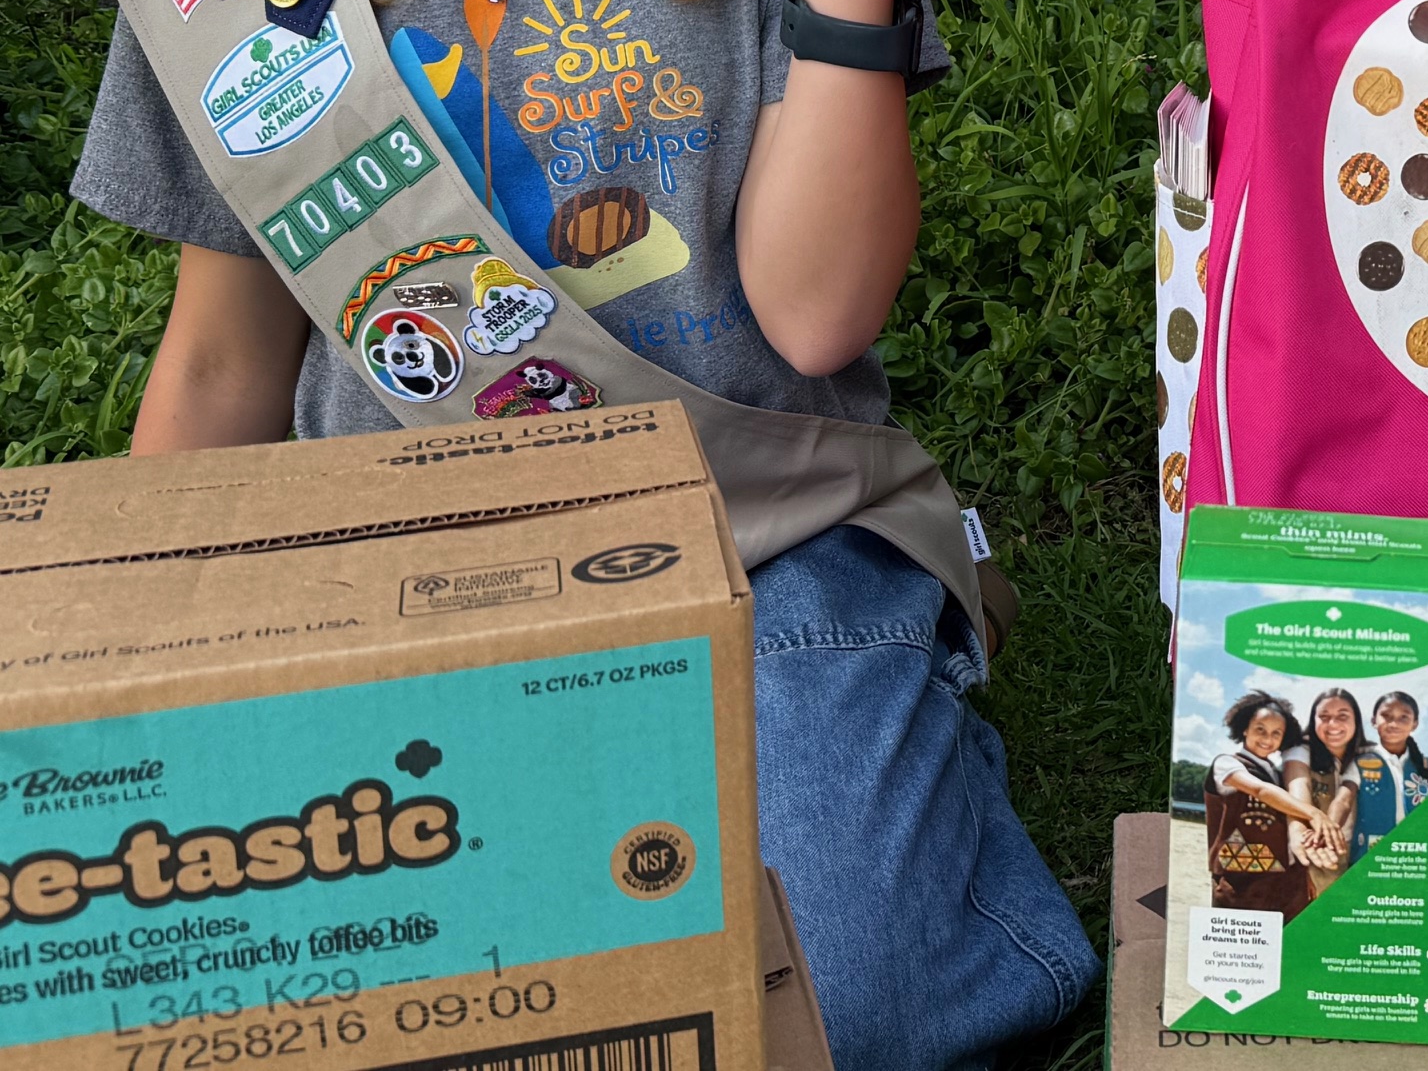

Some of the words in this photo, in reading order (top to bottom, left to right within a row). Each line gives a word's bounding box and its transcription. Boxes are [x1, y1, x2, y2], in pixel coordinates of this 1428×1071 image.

[555, 23, 661, 83] Sun
[211, 86, 243, 115] GIRL
[241, 44, 300, 93] SCOUTS
[255, 122, 278, 145] LOS
[277, 86, 325, 130] ANGELES
[258, 79, 308, 121] GREATER
[518, 71, 644, 132] Surf
[649, 68, 703, 120] &
[268, 131, 423, 257] 70403
[482, 295, 516, 322] STORM
[485, 299, 530, 333] TROOPER
[519, 305, 543, 324] 2025
[516, 420, 590, 438] NOT
[603, 410, 655, 424] DO
[402, 431, 503, 451] DROP
[1255, 623, 1282, 636] The
[1283, 624, 1311, 637] Girl
[1312, 626, 1354, 640] Scout
[1355, 628, 1410, 642] Mission
[521, 680, 542, 696] 12
[545, 671, 605, 693] CT/6.7
[608, 666, 635, 684] OZ
[639, 658, 689, 680] PKGS
[12, 759, 165, 798] Brownie
[623, 830, 681, 854] CERTIFIED
[636, 848, 670, 873] NSF
[38, 930, 121, 964] Scout
